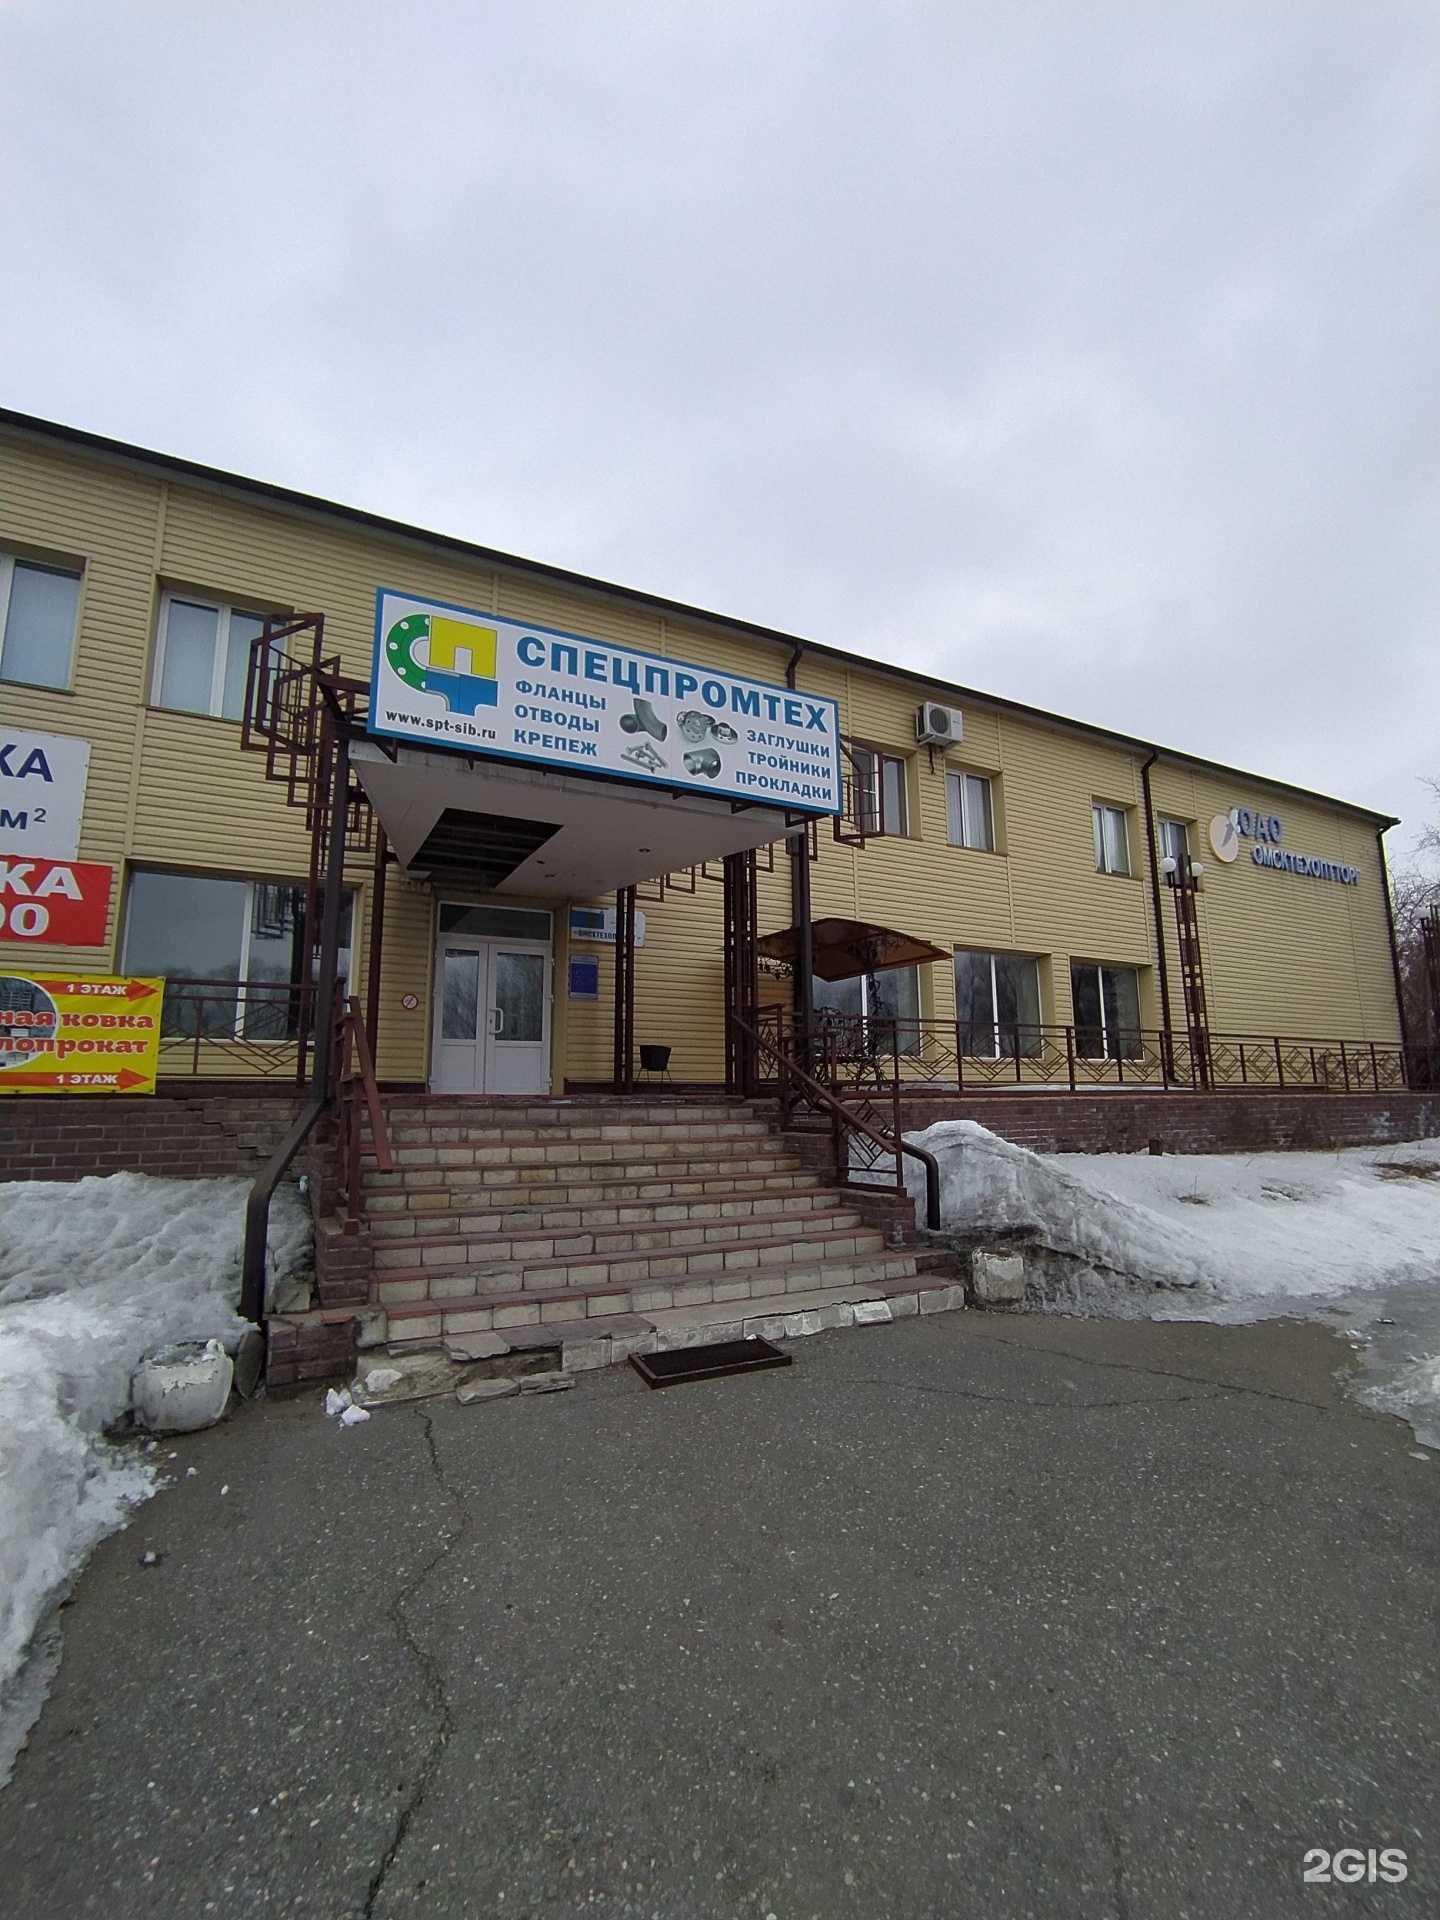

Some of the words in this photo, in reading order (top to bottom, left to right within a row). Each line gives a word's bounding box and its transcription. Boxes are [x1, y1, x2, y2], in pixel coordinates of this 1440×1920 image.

[515, 679, 606, 710] ФЛАНЦЫ
[516, 636, 829, 734] СПЕЦПРОМТЕХ
[385, 709, 496, 740] www.spt-sib.ru
[514, 704, 600, 733] ОТВОДЫ
[513, 728, 598, 757] КРЕПЕЖ
[746, 729, 830, 759] ЗАГЛУШКИ
[748, 751, 831, 779] ТРОЙНИКИ
[735, 770, 832, 800] ПРОКЛАДКИ
[1238, 808, 1282, 843] ОАО
[66, 983, 75, 993] 1
[80, 984, 127, 995] ЭТАЖ
[61, 1013, 154, 1029] ковка
[56, 1075, 64, 1084] 1
[70, 1074, 118, 1084] ЭТАЖ
